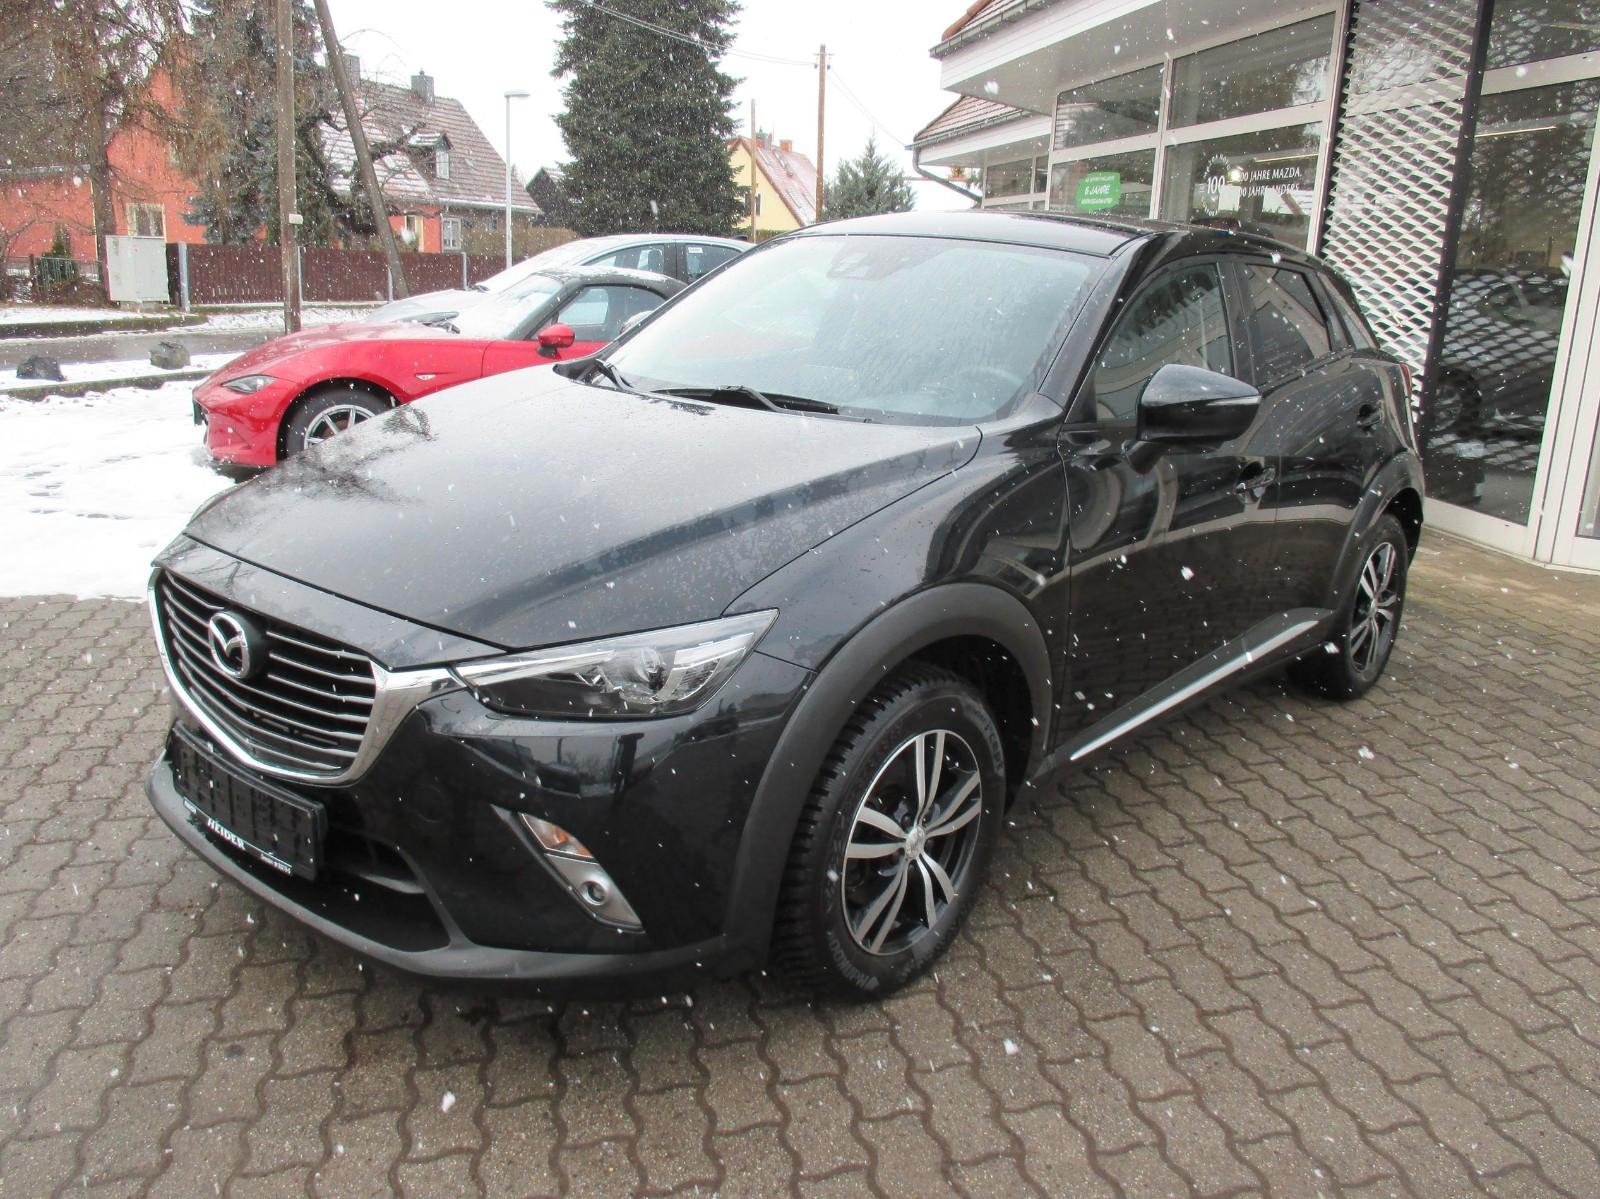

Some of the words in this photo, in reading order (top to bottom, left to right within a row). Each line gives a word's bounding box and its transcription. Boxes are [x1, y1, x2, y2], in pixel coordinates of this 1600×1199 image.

[1249, 169, 1270, 182] JAHRE
[1272, 166, 1302, 179] MAZDA.
[1090, 184, 1111, 195] JAHRE
[1207, 175, 1225, 194] 100
[207, 817, 246, 850] HEIDER
